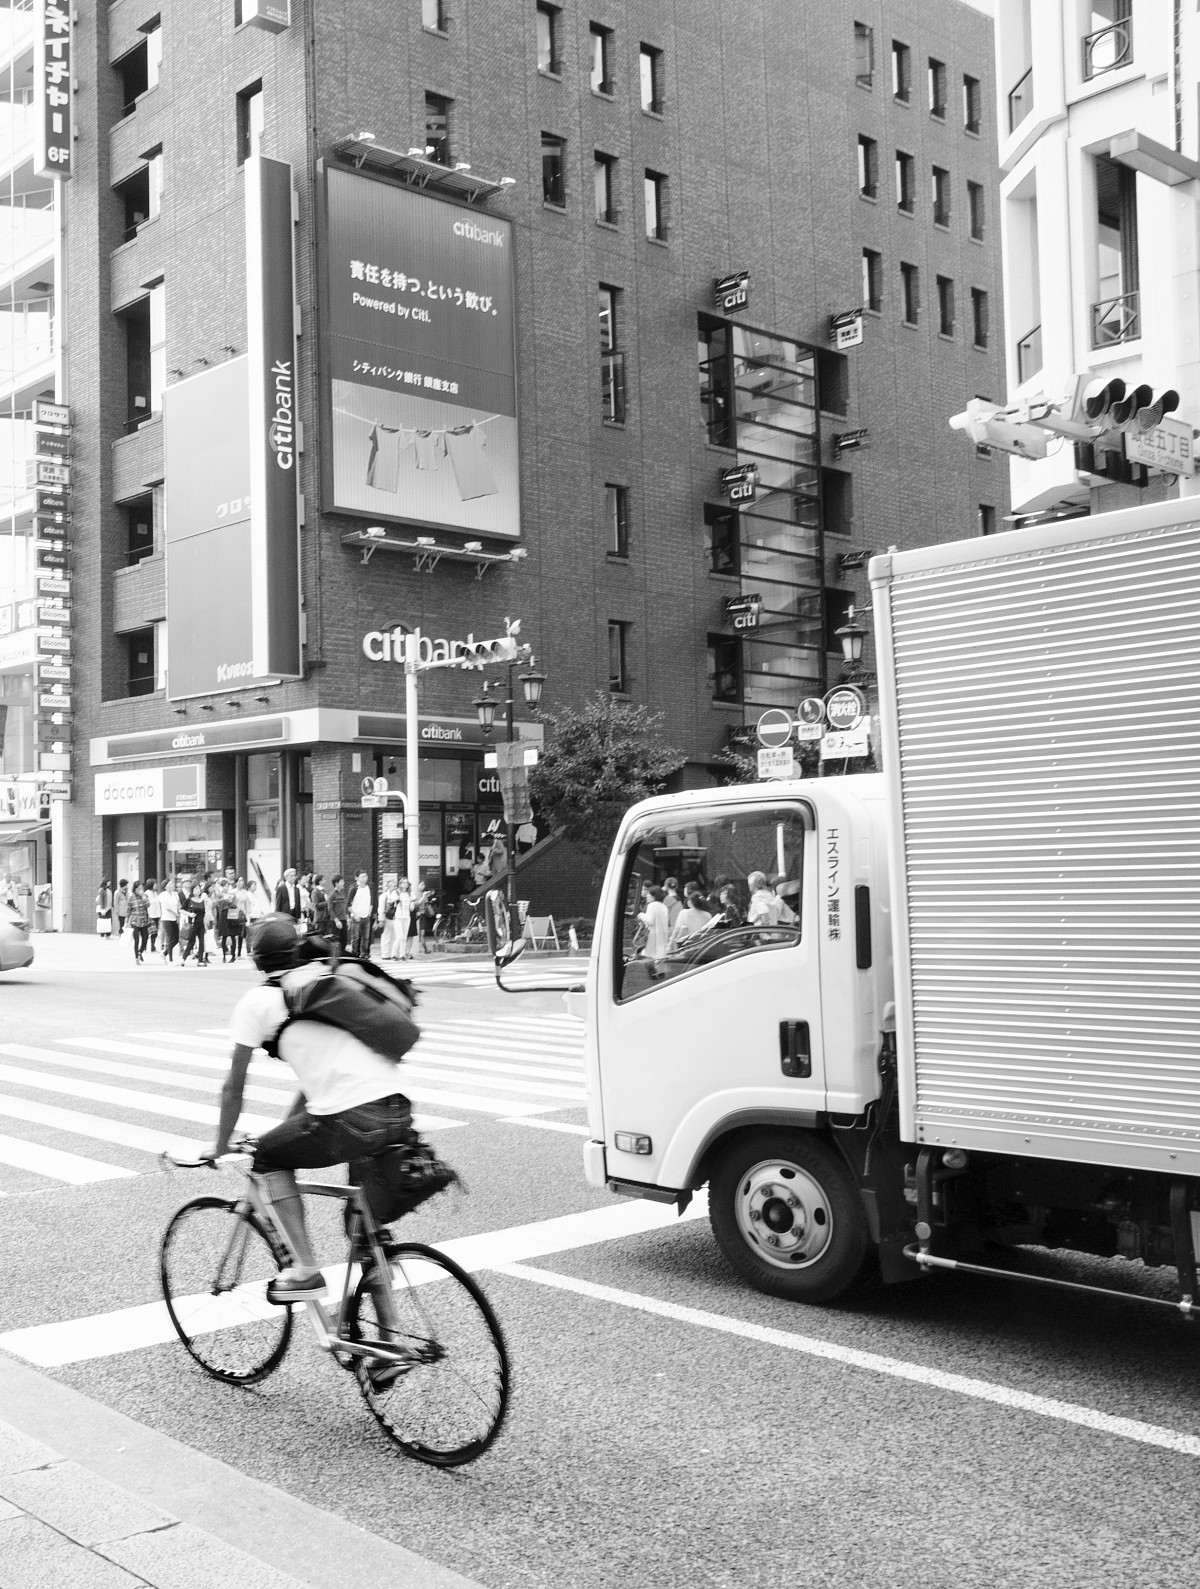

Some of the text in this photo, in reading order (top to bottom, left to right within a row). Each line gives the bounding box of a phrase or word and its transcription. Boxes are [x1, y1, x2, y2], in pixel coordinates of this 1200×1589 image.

[48, 146, 69, 163] 6F
[453, 218, 504, 248] citibank
[724, 289, 746, 308] citi
[353, 292, 432, 323] Powered by Citi.
[353, 360, 459, 394] シティバンク銀行 銀座支店
[270, 360, 293, 470] citibank
[730, 481, 753, 500] citi
[42, 581, 67, 590] docomo
[42, 609, 67, 619] docomo
[734, 612, 757, 630] citi
[42, 638, 67, 648] docomo
[363, 620, 484, 671] citban
[42, 667, 67, 677] docomo
[42, 696, 67, 706] docomo
[830, 702, 857, 717] 消火栓
[172, 733, 205, 748] citibank
[422, 723, 463, 741] citibank
[104, 784, 155, 801] docomo
